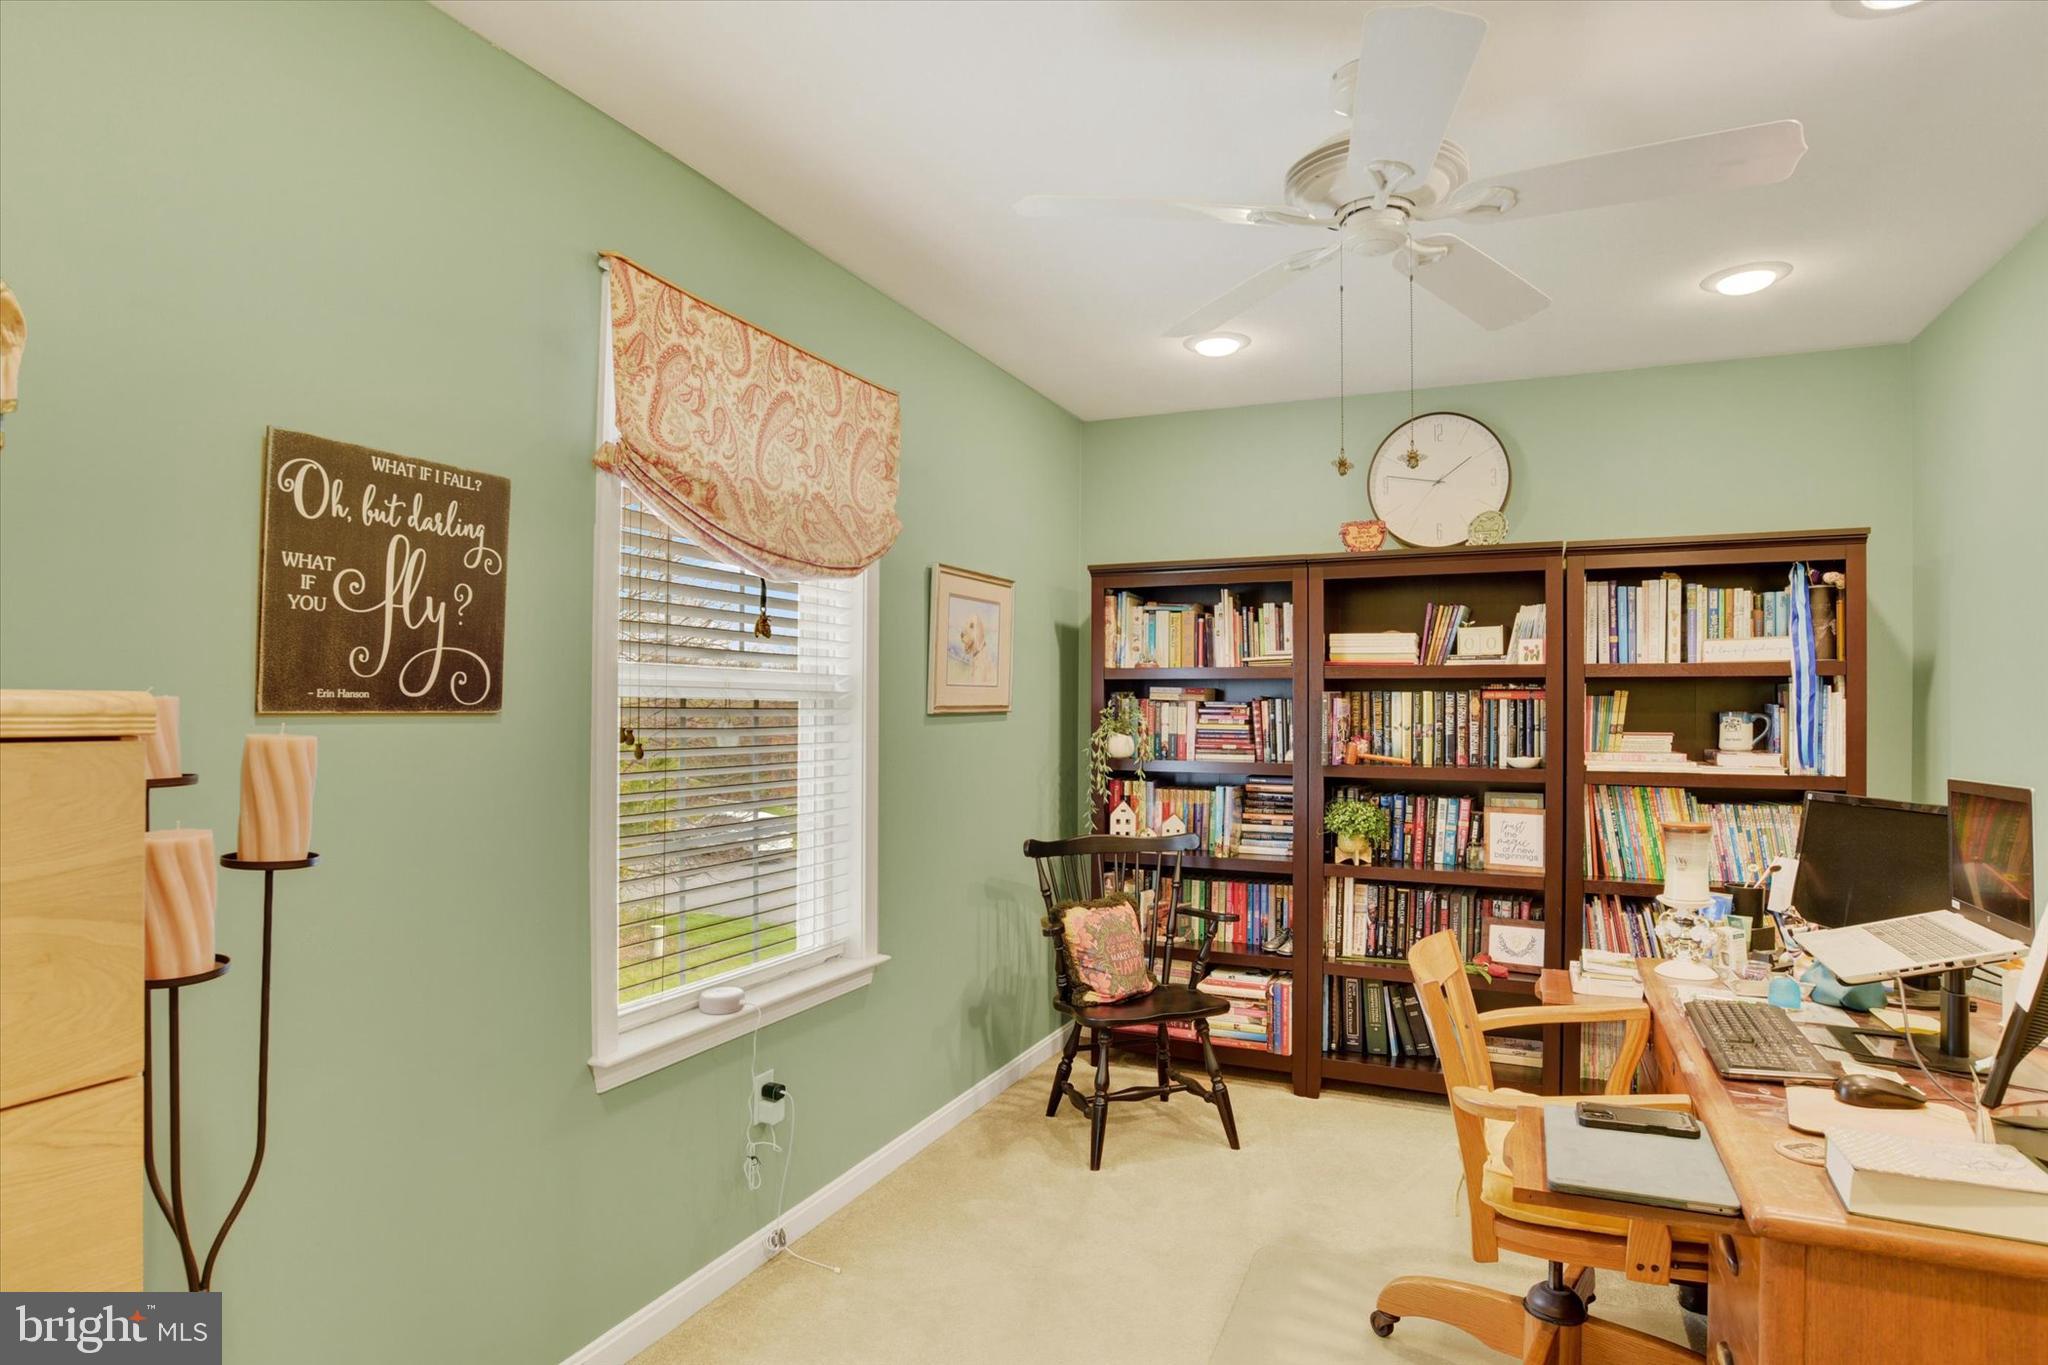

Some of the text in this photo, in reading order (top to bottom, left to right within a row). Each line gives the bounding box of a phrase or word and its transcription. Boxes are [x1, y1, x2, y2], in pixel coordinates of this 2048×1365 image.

[1433, 423, 1443, 443] 12
[371, 455, 483, 492] WHAT IF I FALL?
[277, 457, 502, 575] Oh, but darling
[281, 551, 336, 571] WHAT
[300, 574, 317, 590] IF
[287, 594, 327, 612] YOU
[333, 534, 490, 705] fly?
[316, 688, 335, 698] Erin
[337, 688, 370, 699] Hanson
[1501, 820, 1527, 833] trust
[1494, 852, 1539, 862] beginnings
